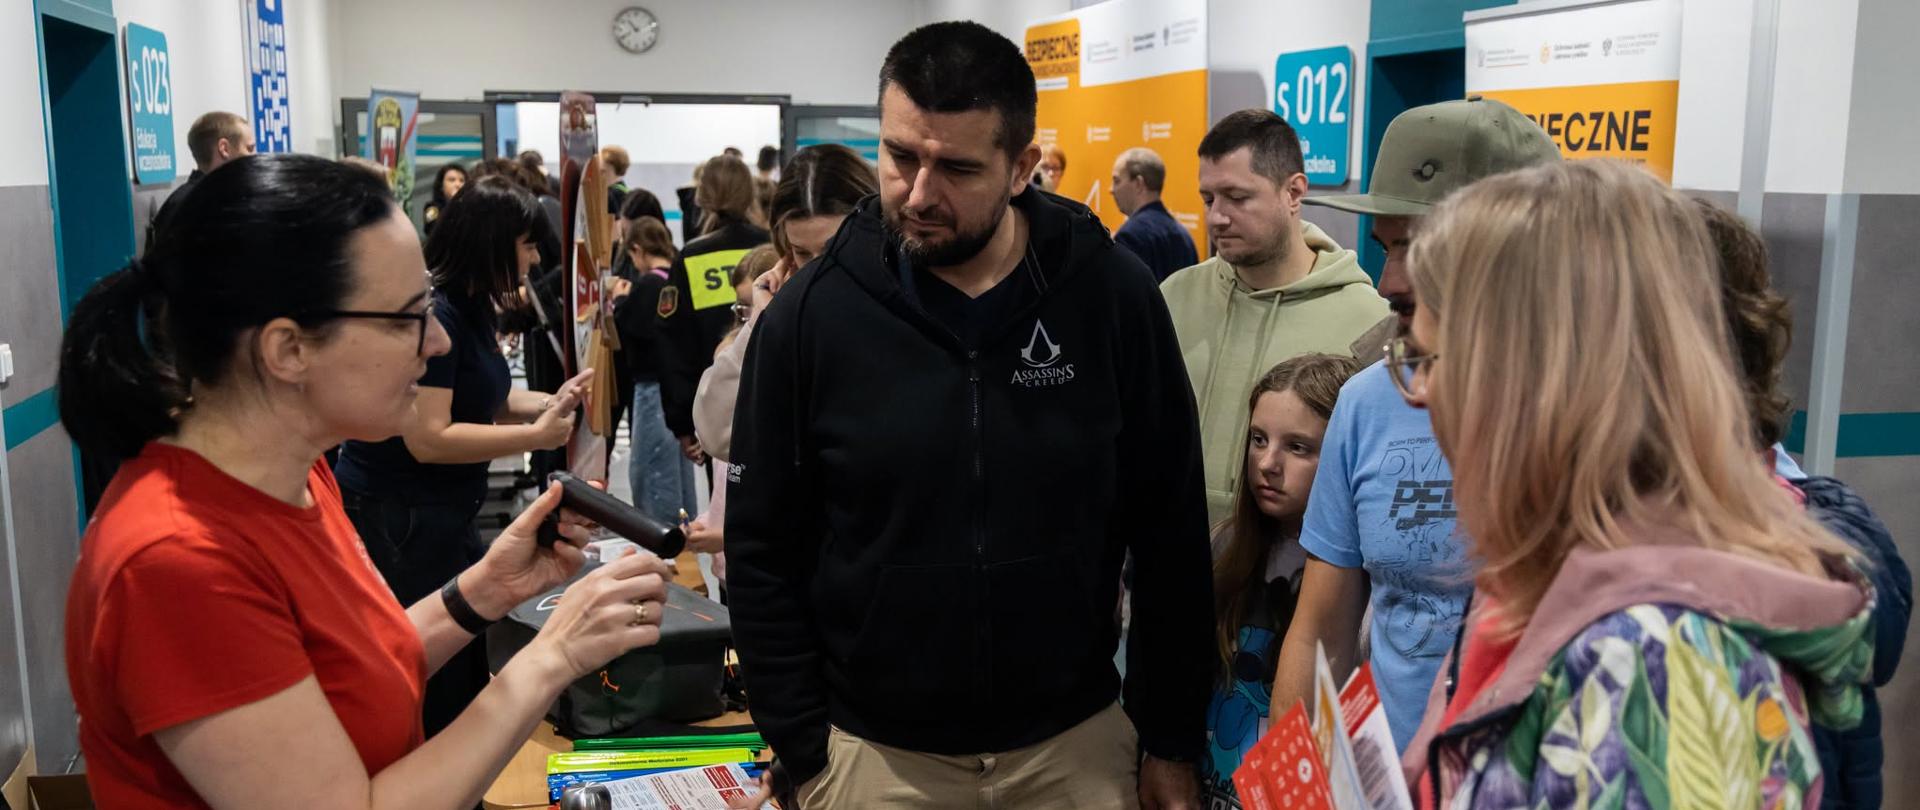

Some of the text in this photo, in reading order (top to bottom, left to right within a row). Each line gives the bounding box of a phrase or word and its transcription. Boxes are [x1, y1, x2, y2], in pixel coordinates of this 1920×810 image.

[142, 46, 170, 115] 023
[1296, 62, 1347, 125] 012
[704, 265, 736, 290] ST
[1025, 377, 1066, 387] CREED
